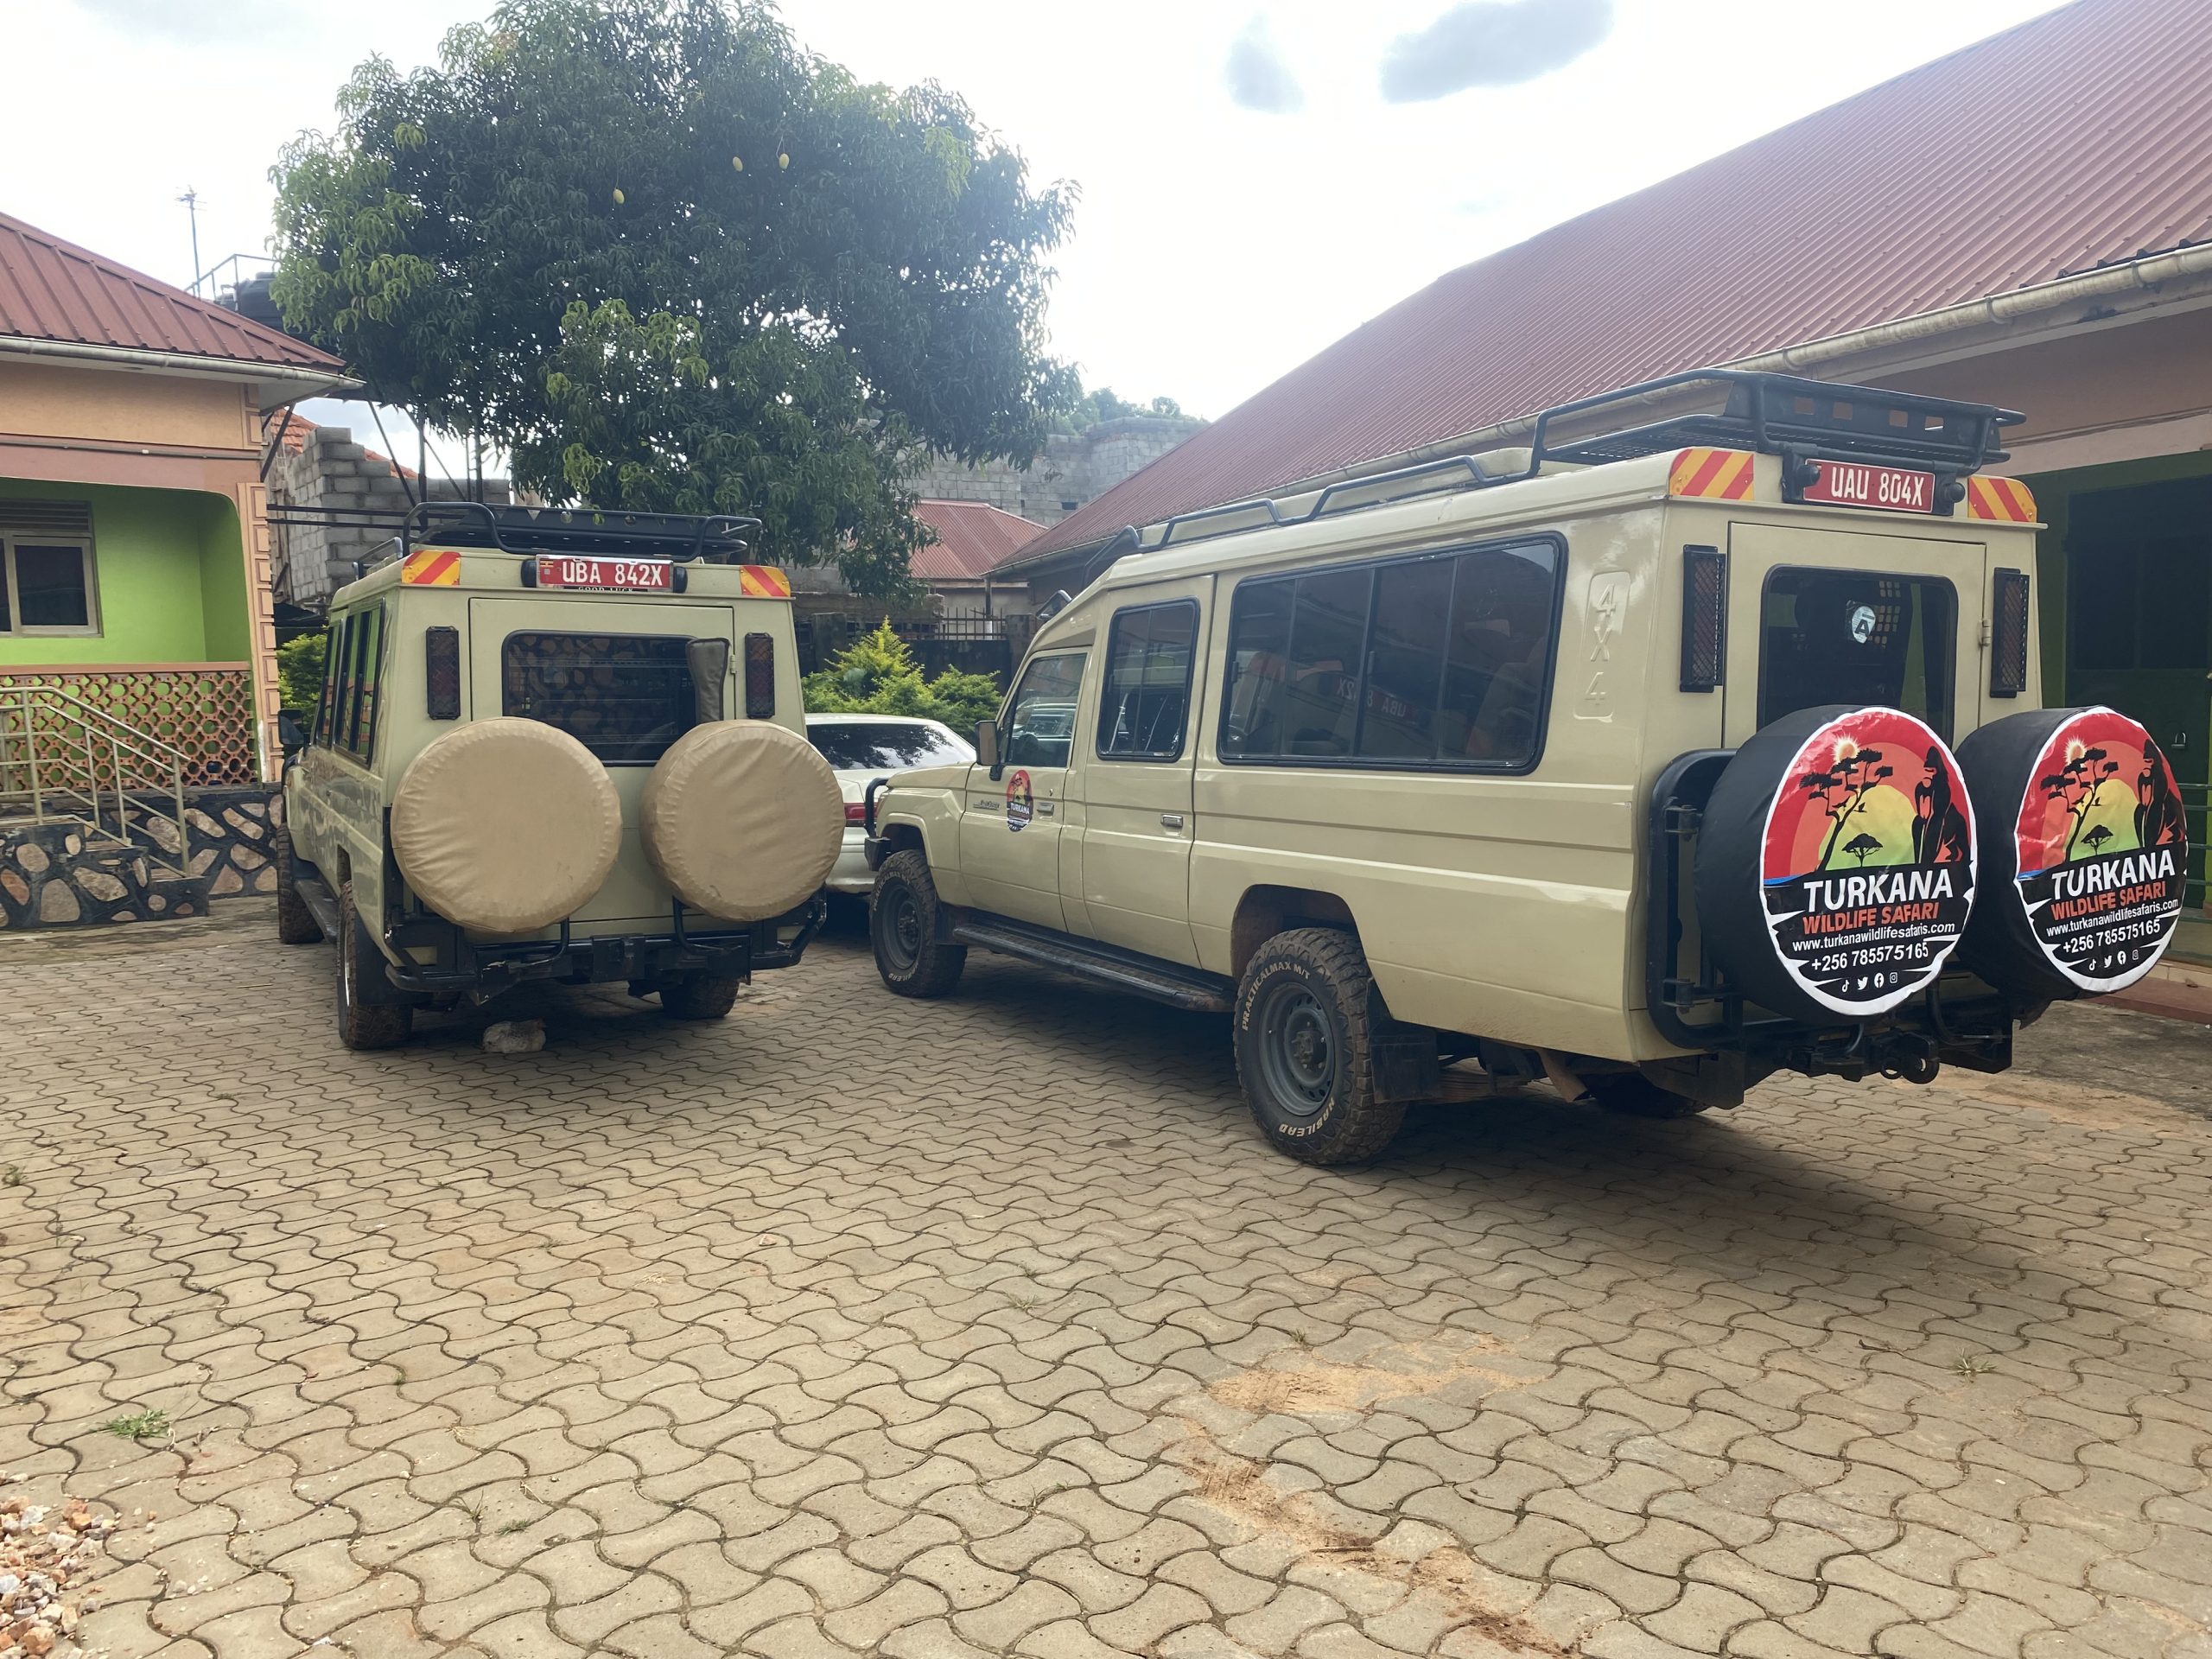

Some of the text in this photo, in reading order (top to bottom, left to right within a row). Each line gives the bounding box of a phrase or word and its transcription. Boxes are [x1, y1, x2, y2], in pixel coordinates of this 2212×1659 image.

[1831, 467, 1924, 506] UAU 804X
[563, 561, 663, 586] UBA 842X
[1854, 619, 1870, 636] A
[1803, 868, 1954, 912] TURKANA
[2051, 849, 2176, 900] TURKANA
[1802, 902, 1940, 935] WILDLIFE SAFARI
[2046, 899, 2179, 937] www.turkanawildlifesafaris.com
[2050, 880, 2166, 921] WILDLIFE SAFARI
[1792, 923, 1955, 951] www.turkanawildlifesafaris.com
[2063, 918, 2161, 954] +256 785575165
[1811, 942, 1929, 972] +256 785575165
[1242, 961, 1292, 1031] PRACTICALMAX
[1279, 1096, 1335, 1137] HABILEAD
